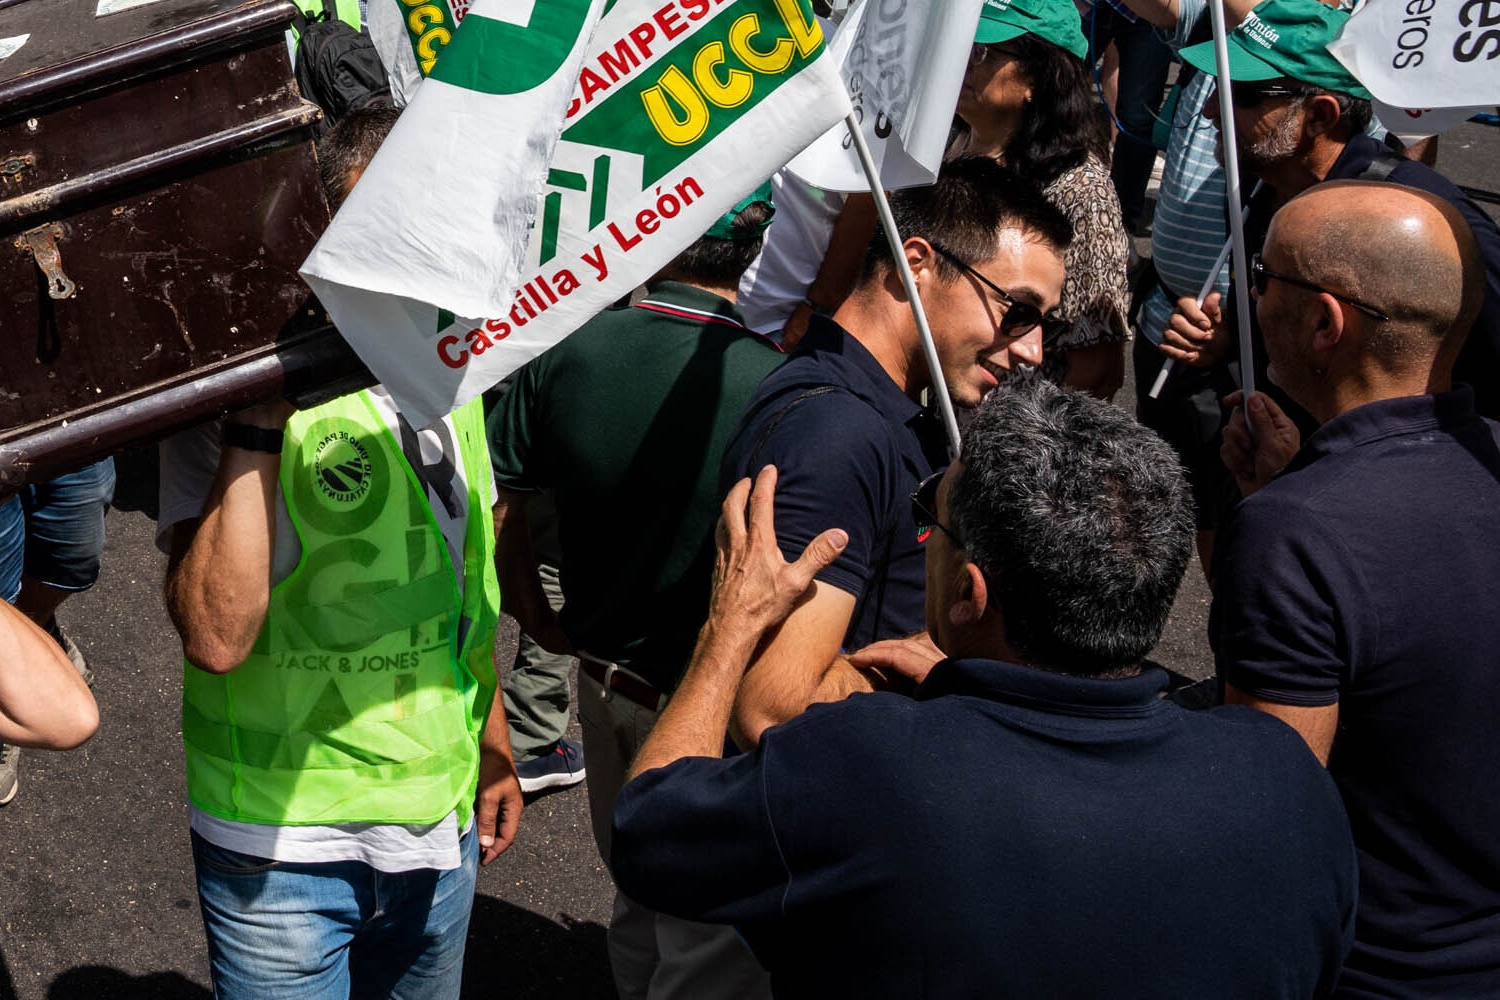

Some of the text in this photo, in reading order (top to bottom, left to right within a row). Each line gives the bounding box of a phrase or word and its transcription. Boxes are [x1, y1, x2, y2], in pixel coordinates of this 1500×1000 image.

[1248, 12, 1280, 44] Unión
[1249, 29, 1273, 50] Uniones
[436, 176, 705, 369] Castilla y León
[276, 651, 420, 673] JACK & JONES
